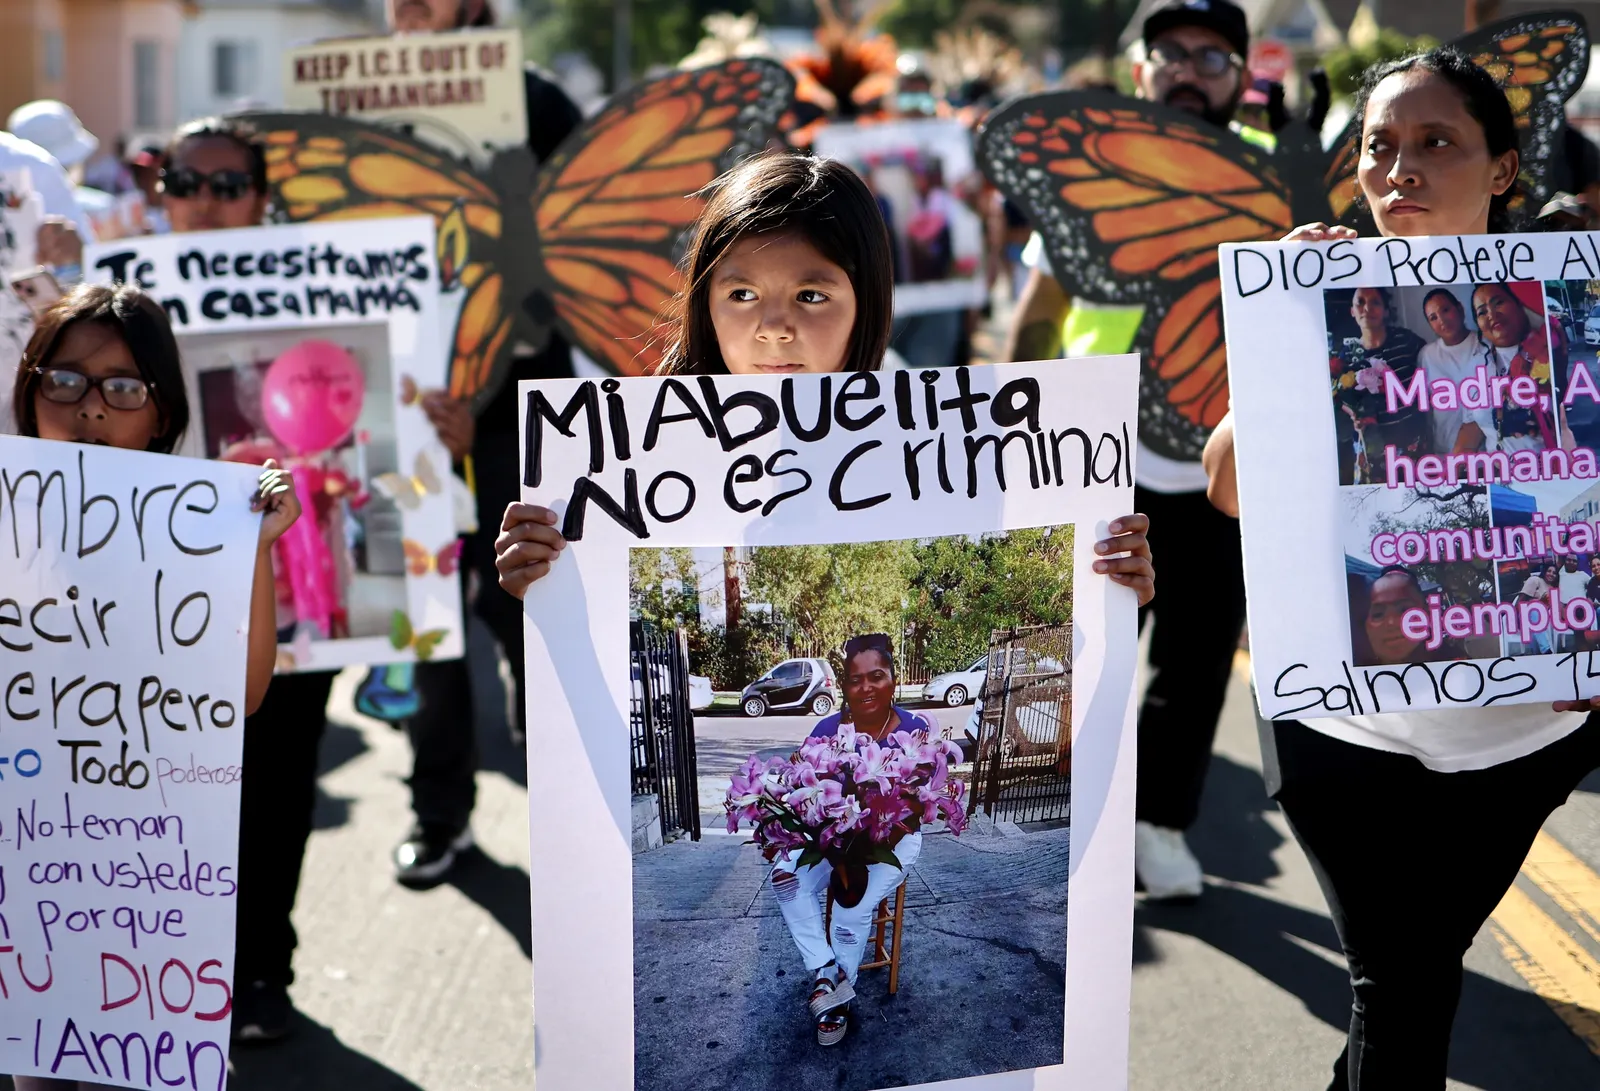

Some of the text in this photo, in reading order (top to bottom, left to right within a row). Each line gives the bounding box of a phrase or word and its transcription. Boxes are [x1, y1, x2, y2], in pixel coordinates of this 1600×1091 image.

[294, 54, 350, 83] KEEP
[420, 45, 468, 73] OUT
[479, 42, 507, 68] OF
[95, 243, 429, 290] Te necesitamos
[1234, 239, 1363, 298] DIOS
[1376, 238, 1535, 287] Proteje
[1382, 366, 1550, 414] Madre,
[0, 450, 223, 562] mbre
[561, 466, 696, 542] No
[724, 449, 812, 517] es
[1371, 512, 1600, 565] comunita
[155, 569, 211, 655] lo
[1400, 587, 1596, 650] ejemplo
[58, 739, 150, 790] Todo
[17, 799, 54, 850] No
[61, 791, 183, 844] teman
[29, 862, 82, 885] con
[92, 849, 237, 897] ustedes
[101, 952, 232, 1022] DIOS
